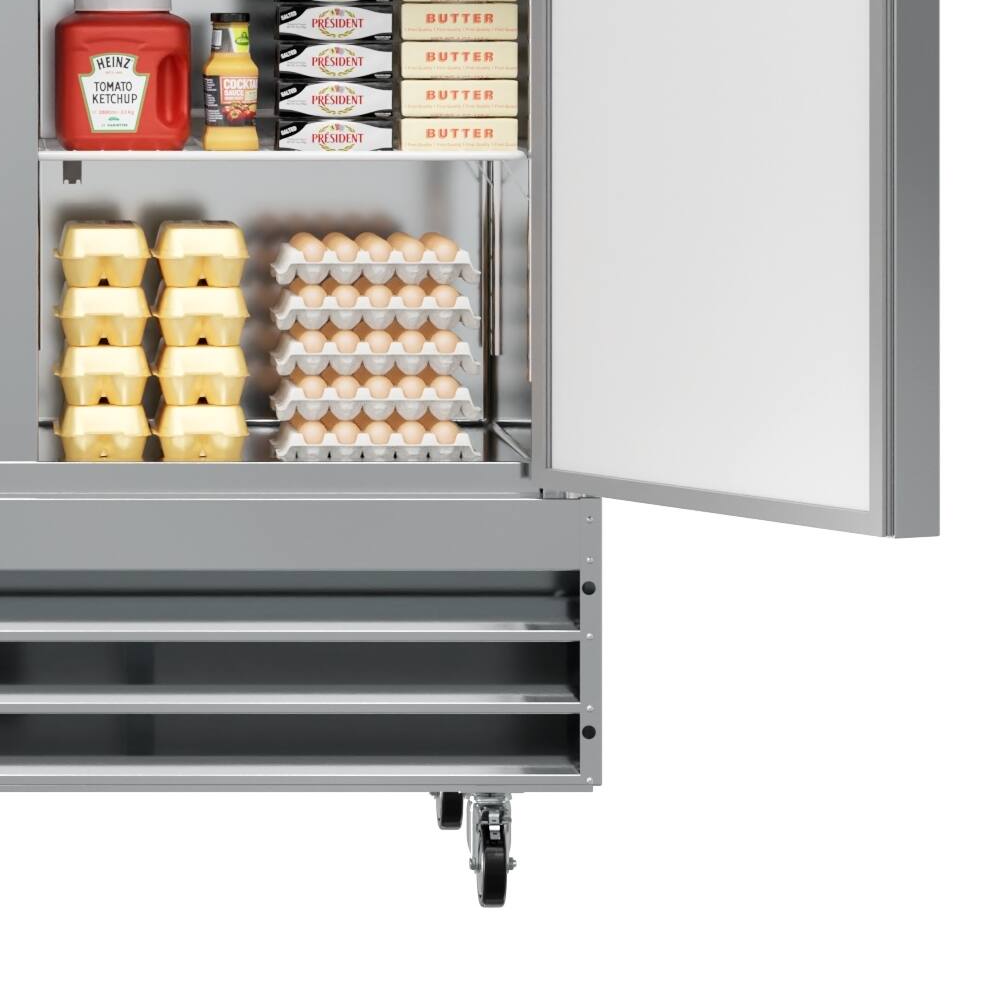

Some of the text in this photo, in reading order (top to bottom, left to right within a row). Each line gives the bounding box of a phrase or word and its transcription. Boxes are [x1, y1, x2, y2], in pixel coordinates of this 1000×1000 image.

[312, 17, 364, 29] PRÉSIDENT
[425, 13, 494, 24] BUTTER
[312, 55, 364, 67] PRÉSIDENT
[425, 52, 494, 62] BUTTER
[96, 56, 131, 70] HEINZ
[94, 81, 133, 92] TOMATO
[92, 93, 138, 104] KETCHUP
[312, 94, 364, 106] PRÉSIDENT
[425, 90, 494, 100] BUTTER
[312, 132, 364, 144] PRÉSIDENT
[425, 128, 494, 138] BUTTER
